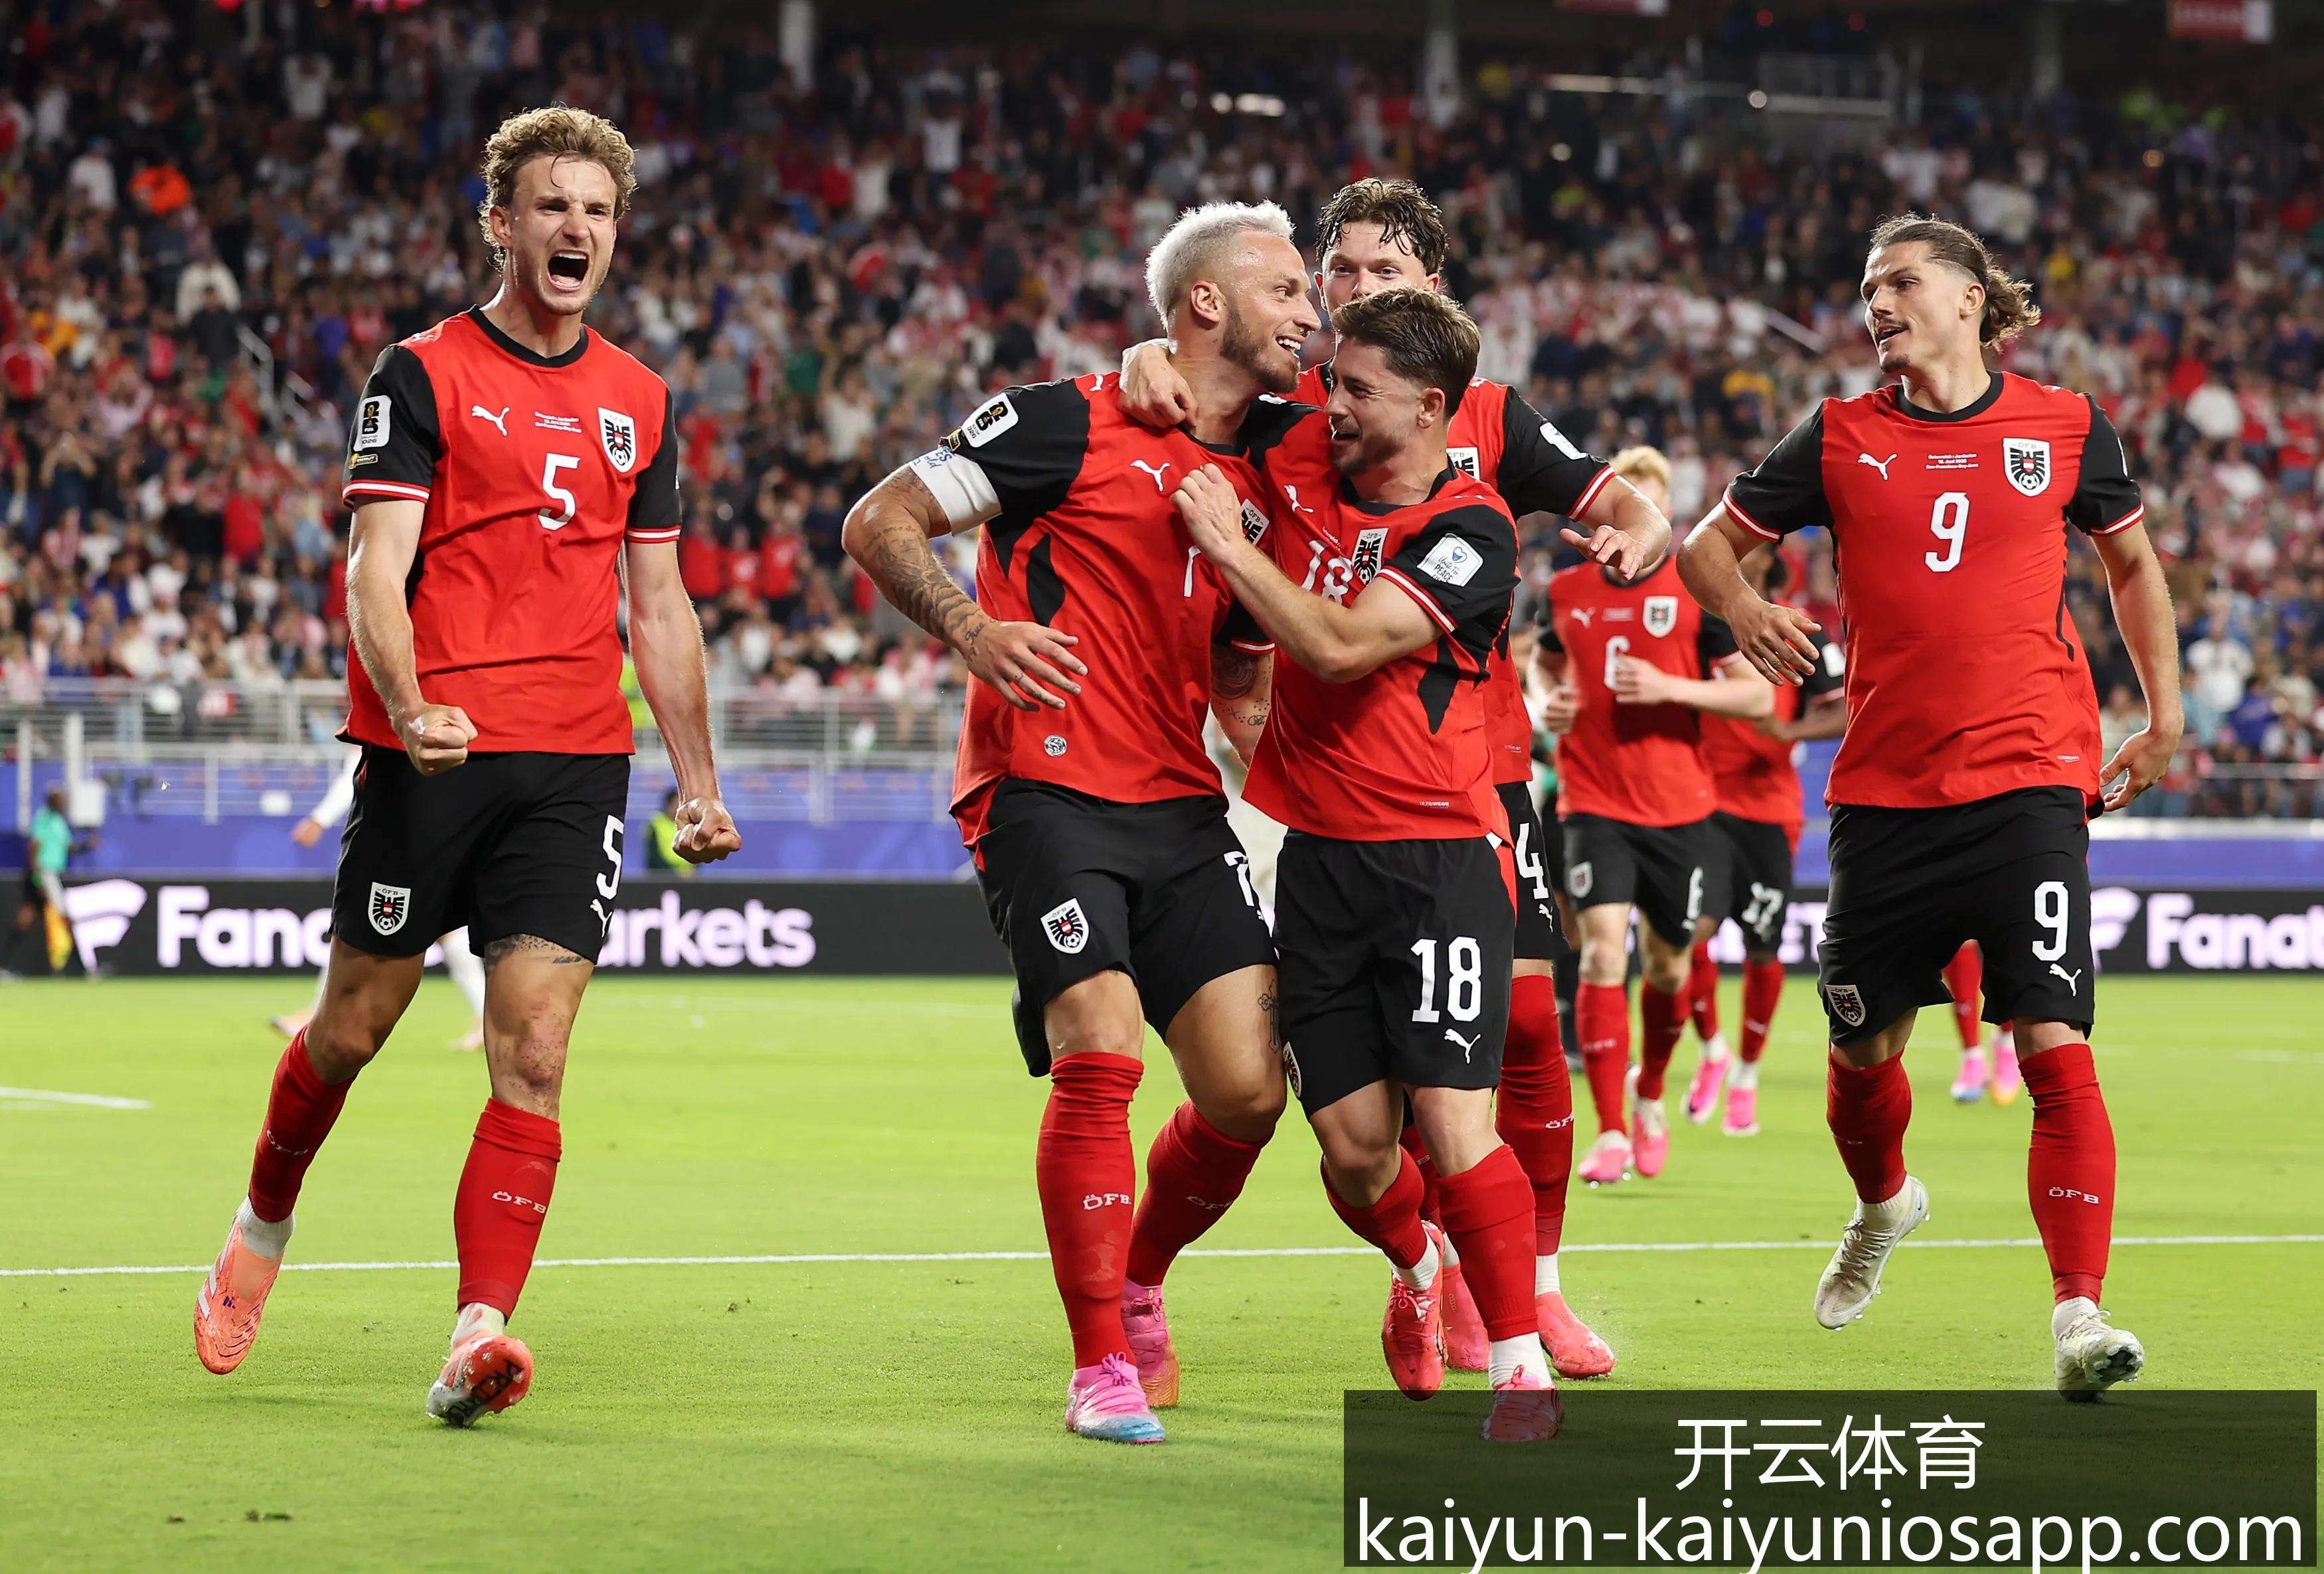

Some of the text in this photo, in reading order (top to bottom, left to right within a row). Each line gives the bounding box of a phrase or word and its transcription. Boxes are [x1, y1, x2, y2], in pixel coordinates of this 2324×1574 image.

[538, 453, 580, 530] 5
[1925, 492, 1969, 572] 9
[1301, 539, 1354, 606] 18
[596, 815, 624, 900] 5
[1515, 823, 1549, 900] 4
[2032, 881, 2068, 961] 9
[1410, 936, 1481, 1023] 18
[492, 1190, 546, 1214] ÖFB
[1083, 1193, 1131, 1210] ÖFB
[2048, 1186, 2100, 1204] ÖFB
